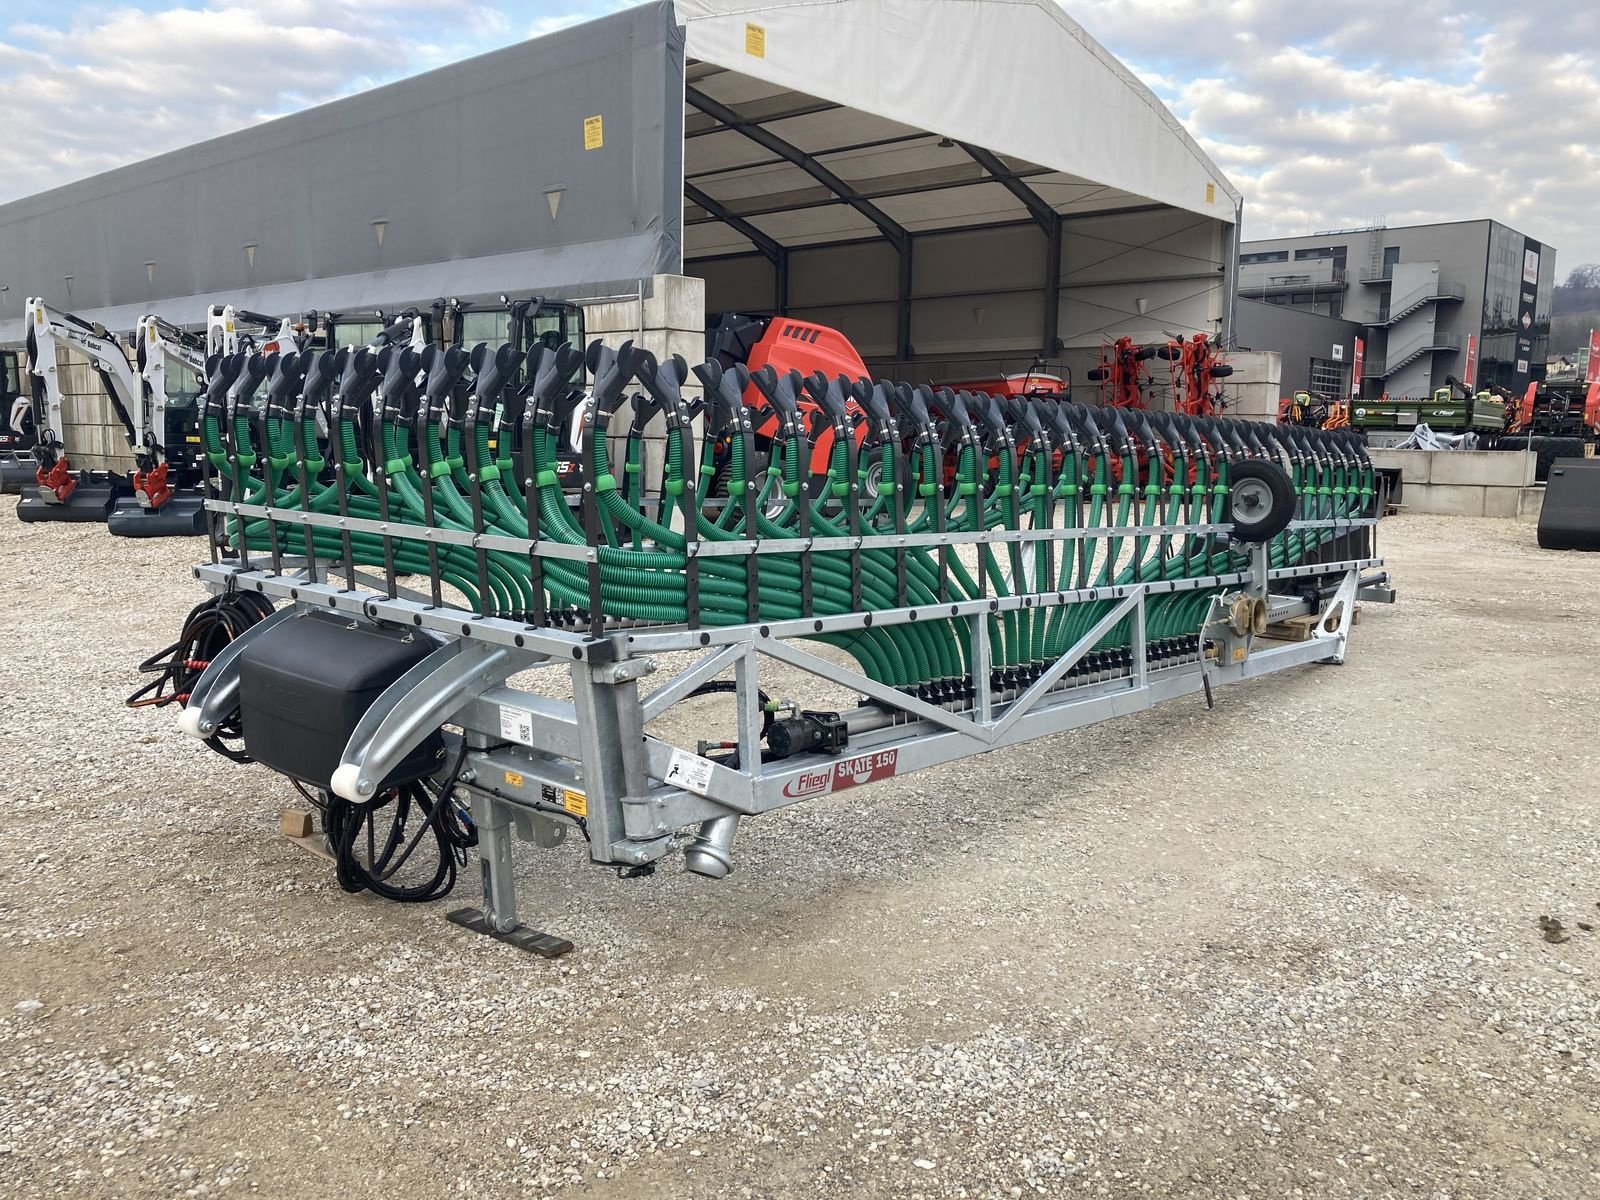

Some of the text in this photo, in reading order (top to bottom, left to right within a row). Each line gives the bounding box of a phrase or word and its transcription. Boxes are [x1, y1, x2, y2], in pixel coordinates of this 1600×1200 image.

[87, 341, 102, 352] Bobcat
[189, 357, 204, 367] Bobcat
[838, 751, 895, 777] SKATE 150
[797, 768, 831, 790] Fliegl
